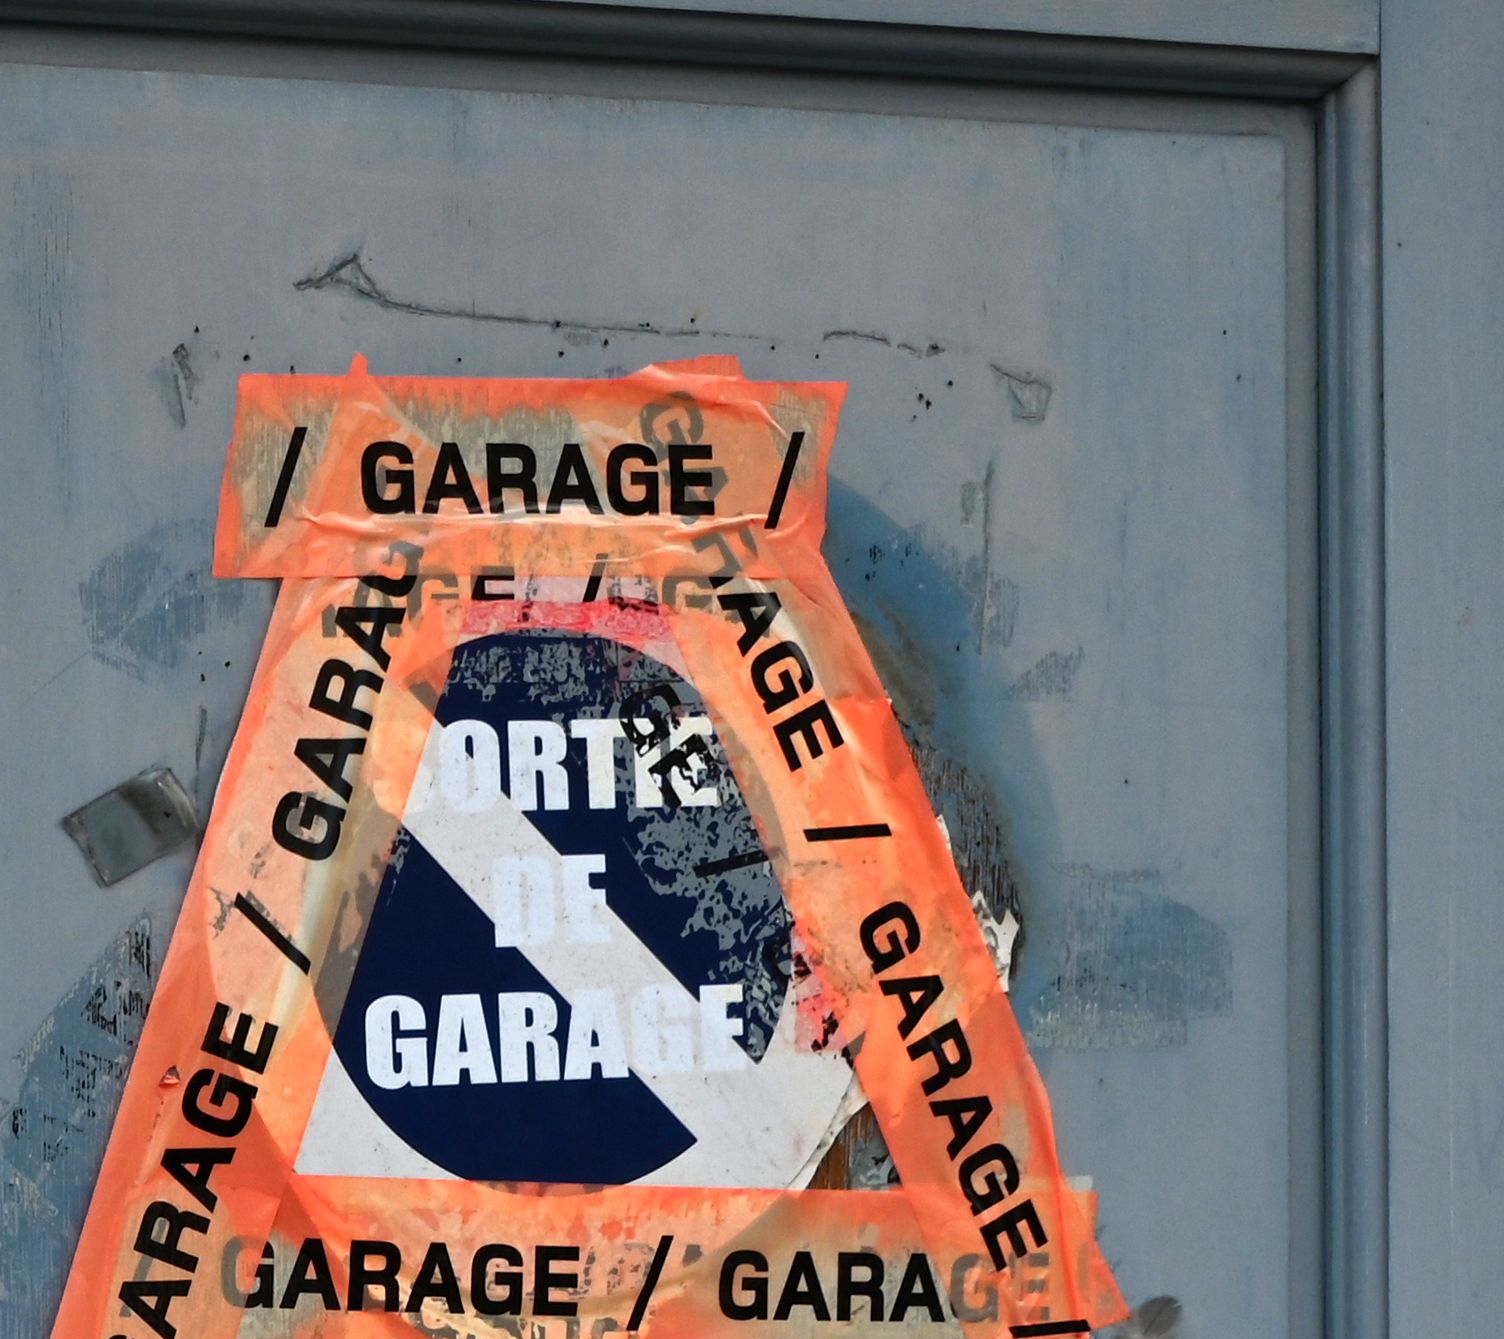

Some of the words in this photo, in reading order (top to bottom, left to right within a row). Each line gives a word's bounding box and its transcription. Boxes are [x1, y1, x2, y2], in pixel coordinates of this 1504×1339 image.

[360, 441, 715, 516] GARAGE
[493, 853, 611, 948] DE
[363, 983, 749, 1090] GARAGE
[858, 900, 1048, 1273] GARAGE
[222, 1240, 580, 1318] GARAGE
